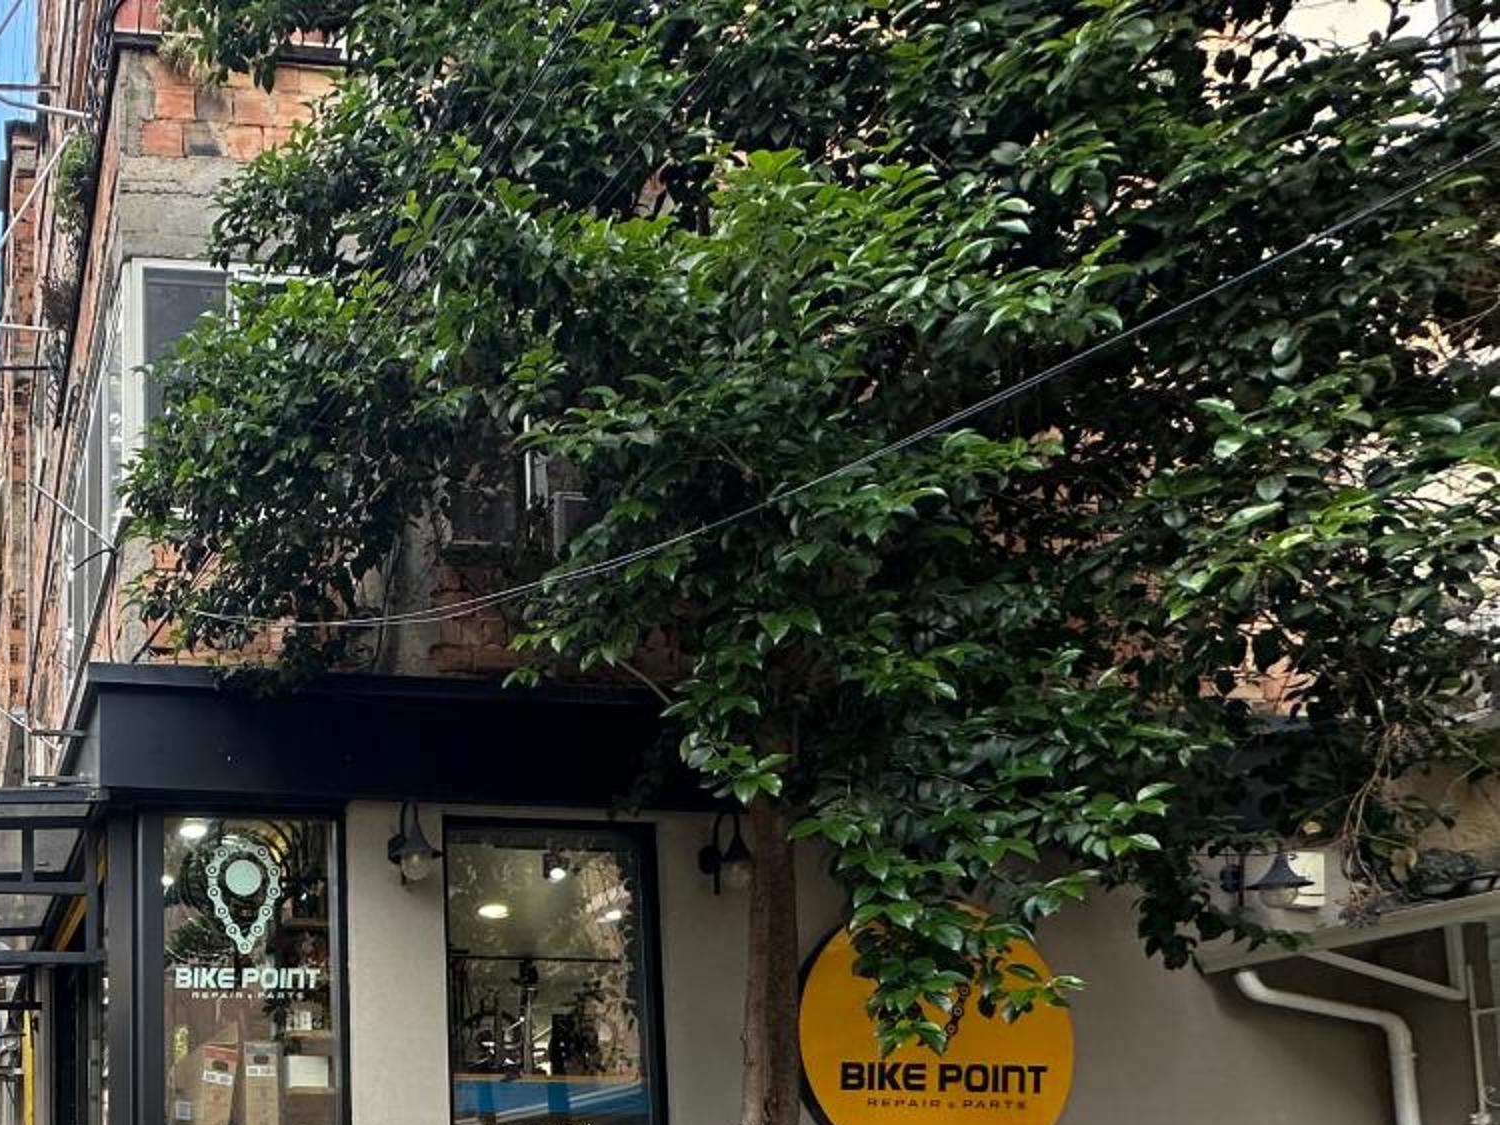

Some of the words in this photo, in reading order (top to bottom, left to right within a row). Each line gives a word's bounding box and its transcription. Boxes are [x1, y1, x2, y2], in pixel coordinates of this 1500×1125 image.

[175, 967, 235, 989] BIKE
[242, 967, 321, 989] POINT
[191, 991, 243, 999] REPAIR
[258, 991, 305, 999] PARTS
[841, 1061, 927, 1091] BIKE
[938, 1063, 1048, 1094] POINT
[867, 1098, 941, 1108] REPAIR
[963, 1099, 1028, 1110] PARTS
